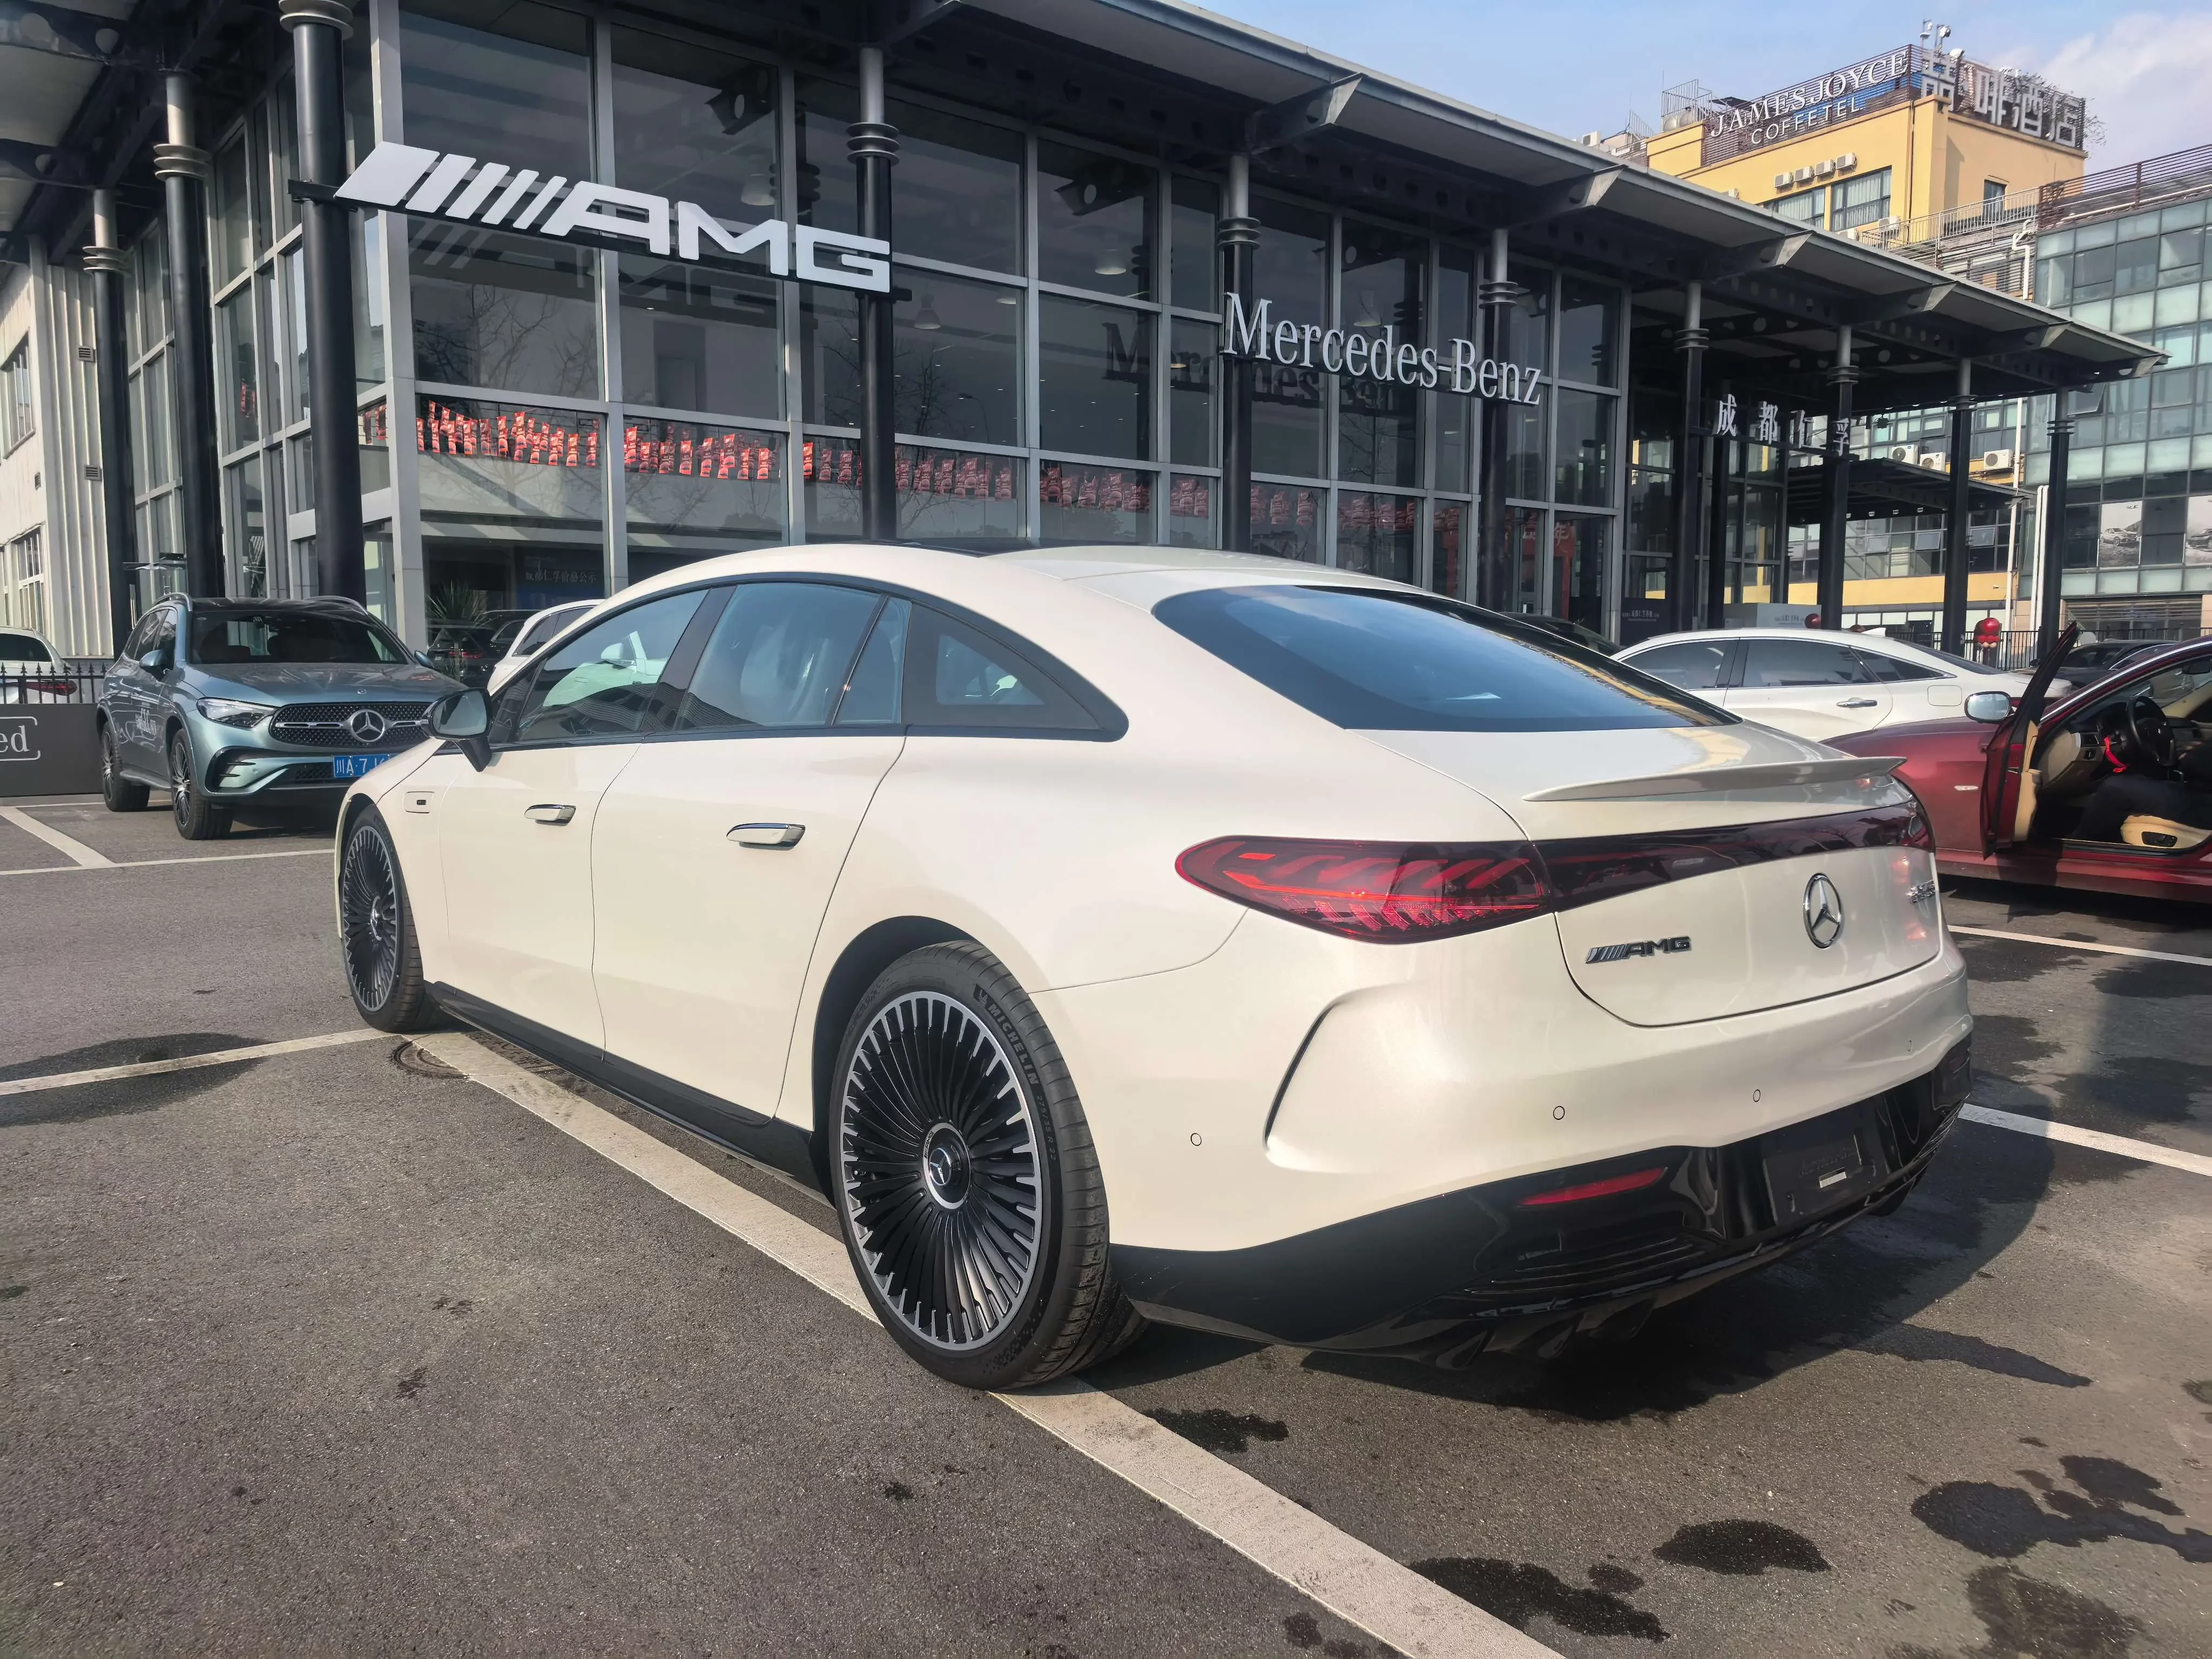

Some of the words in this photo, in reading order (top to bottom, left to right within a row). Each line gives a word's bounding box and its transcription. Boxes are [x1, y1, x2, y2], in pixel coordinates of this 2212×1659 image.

[1711, 87, 1806, 137] JAMES
[1810, 51, 1908, 103] JOYCE
[1751, 97, 1861, 144] COFFETEL
[541, 180, 891, 293] AMG
[1220, 292, 1541, 405] Mercedes-Benz
[1715, 394, 1850, 456] 成都仁孚
[989, 1003, 1040, 1084] MICHELIN
